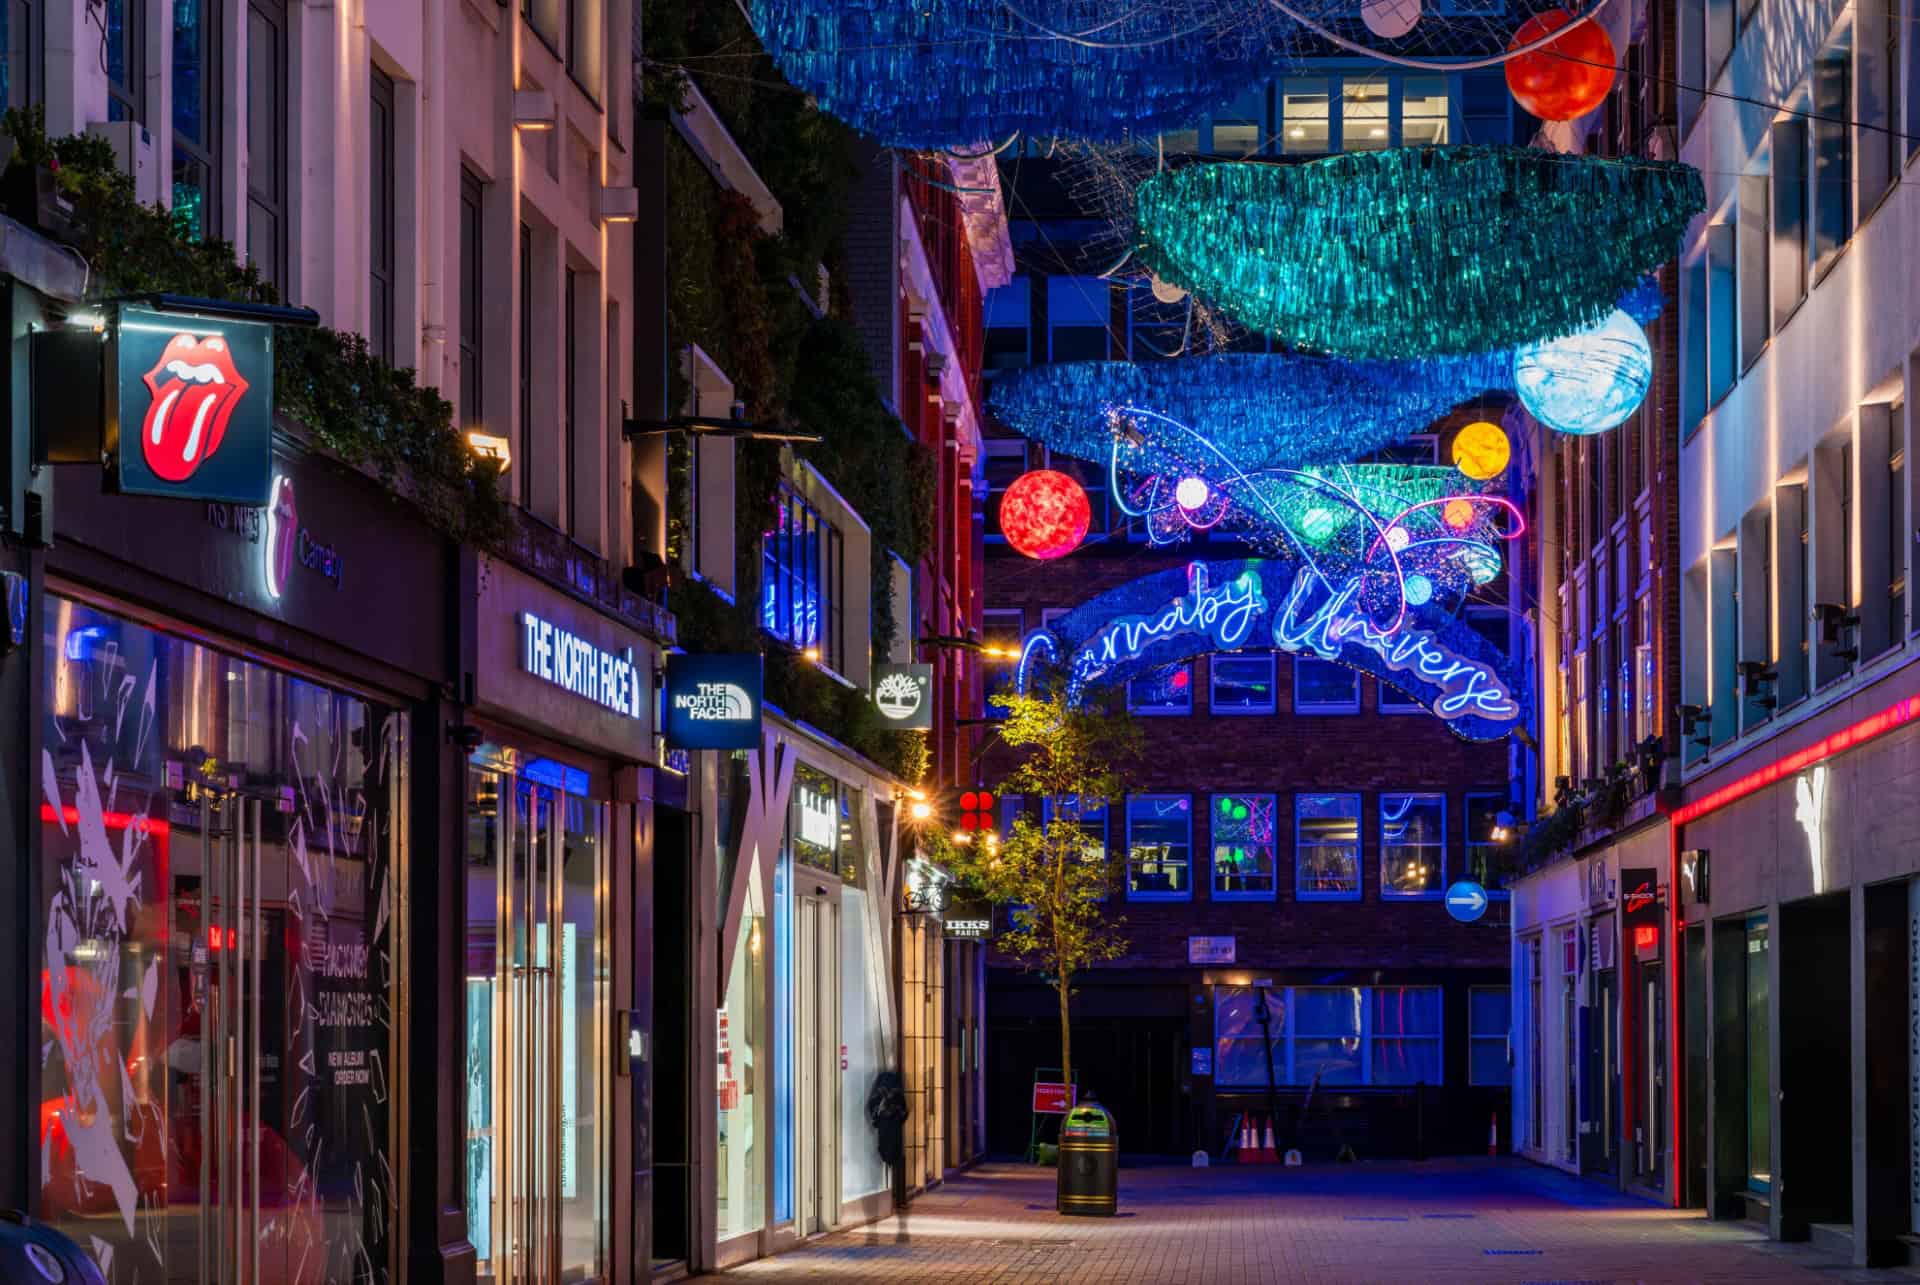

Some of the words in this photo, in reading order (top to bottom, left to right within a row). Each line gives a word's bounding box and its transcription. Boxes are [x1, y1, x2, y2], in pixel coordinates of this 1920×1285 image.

[1280, 572, 1512, 711] Universe
[525, 612, 552, 681] THE
[554, 627, 598, 701] NORTH
[600, 651, 629, 715] FACE
[697, 683, 725, 696] THE
[675, 695, 725, 708] NORTH
[690, 708, 725, 720] FACE
[945, 920, 990, 929] IKKS
[955, 929, 980, 937] PARIS
[322, 943, 369, 979] HACKNEY
[319, 991, 373, 1026] DIAMONDS
[328, 1051, 342, 1066] NEW
[343, 1052, 365, 1066] ALBUM
[335, 1069, 355, 1085] ORDER
[355, 1069, 370, 1085] NOW
